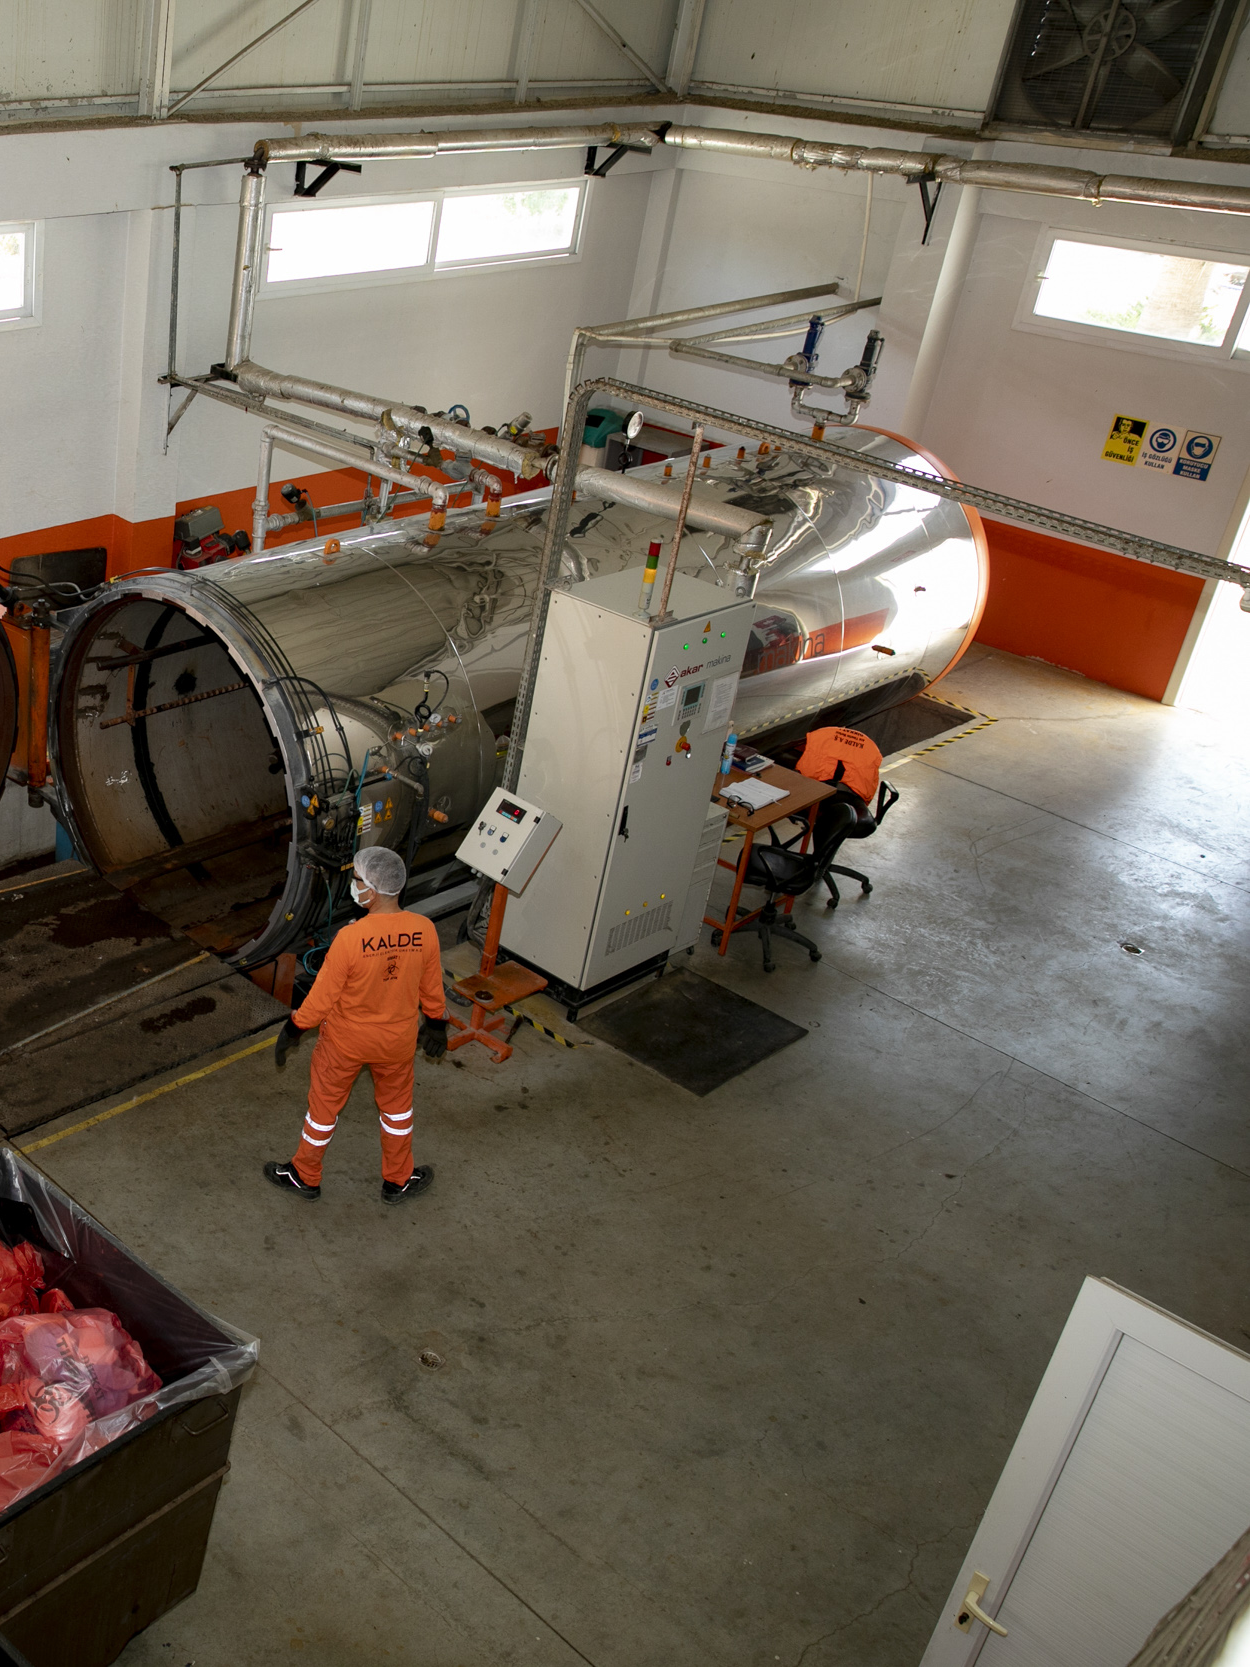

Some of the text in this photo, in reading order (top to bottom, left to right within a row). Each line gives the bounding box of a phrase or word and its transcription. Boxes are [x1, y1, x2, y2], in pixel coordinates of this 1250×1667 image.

[1123, 436, 1140, 446] ÖNCE
[1127, 445, 1134, 454] İŞ
[1105, 450, 1134, 462] GÜVENLİĞİ
[1144, 461, 1165, 470] KULLAN
[1182, 465, 1202, 474] MASKE
[1180, 471, 1200, 479] KULLAN
[680, 654, 732, 678] akar makina
[844, 739, 864, 748] KALDE
[362, 932, 423, 952] KALDE
